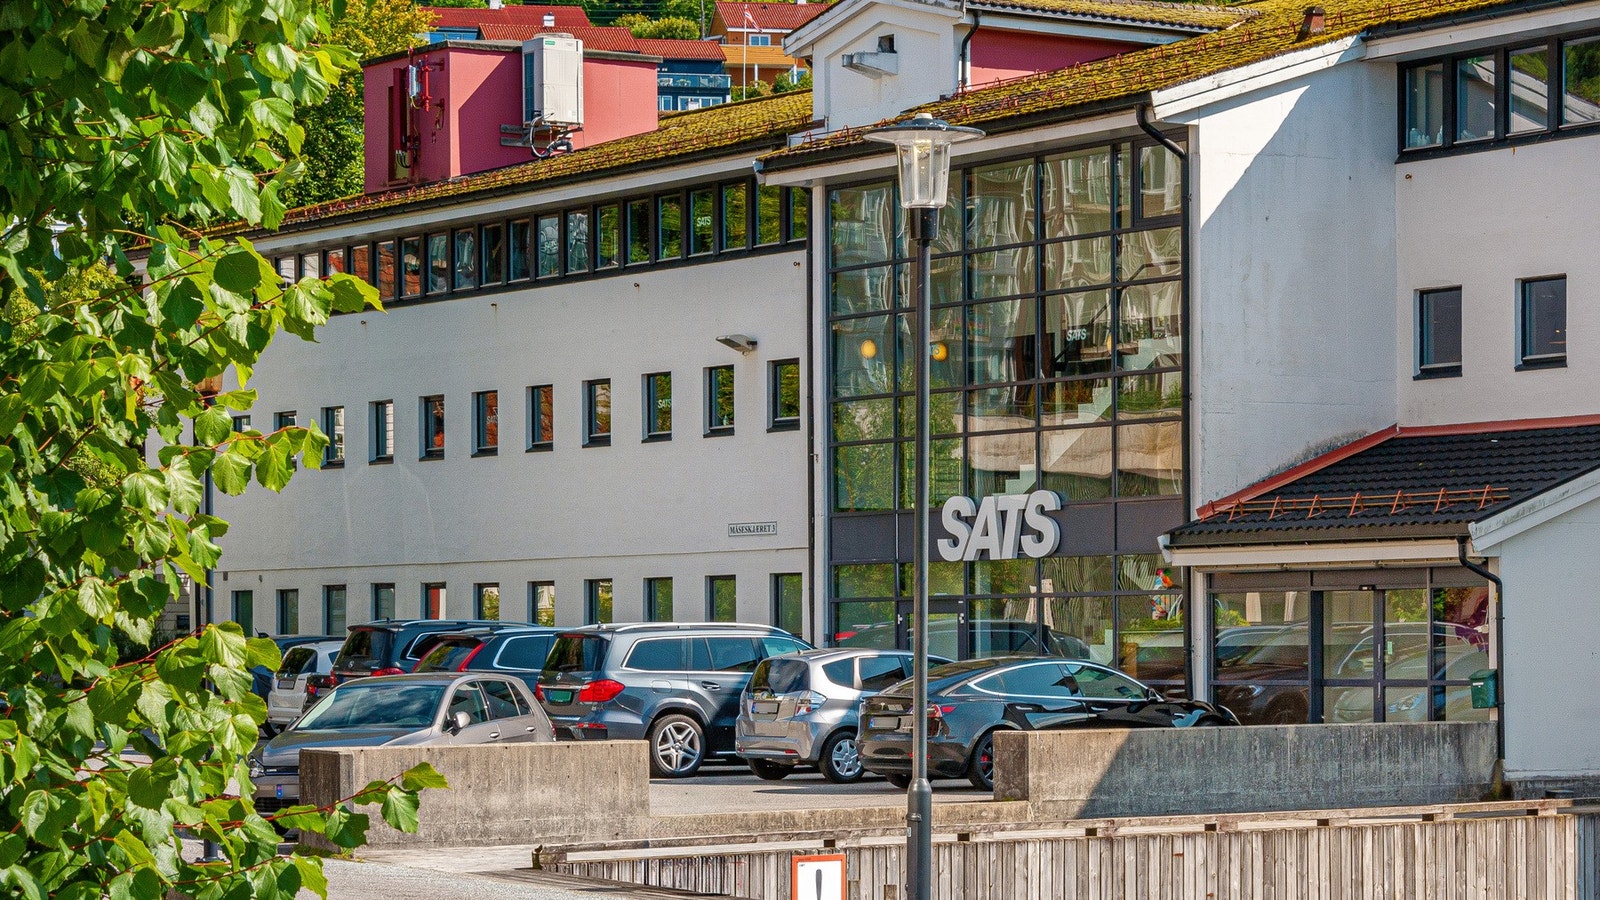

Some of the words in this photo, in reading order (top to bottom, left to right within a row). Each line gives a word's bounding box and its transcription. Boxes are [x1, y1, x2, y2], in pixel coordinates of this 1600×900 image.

[697, 216, 711, 227] SATS
[1066, 328, 1087, 341] SATS
[937, 489, 1062, 562] SATS
